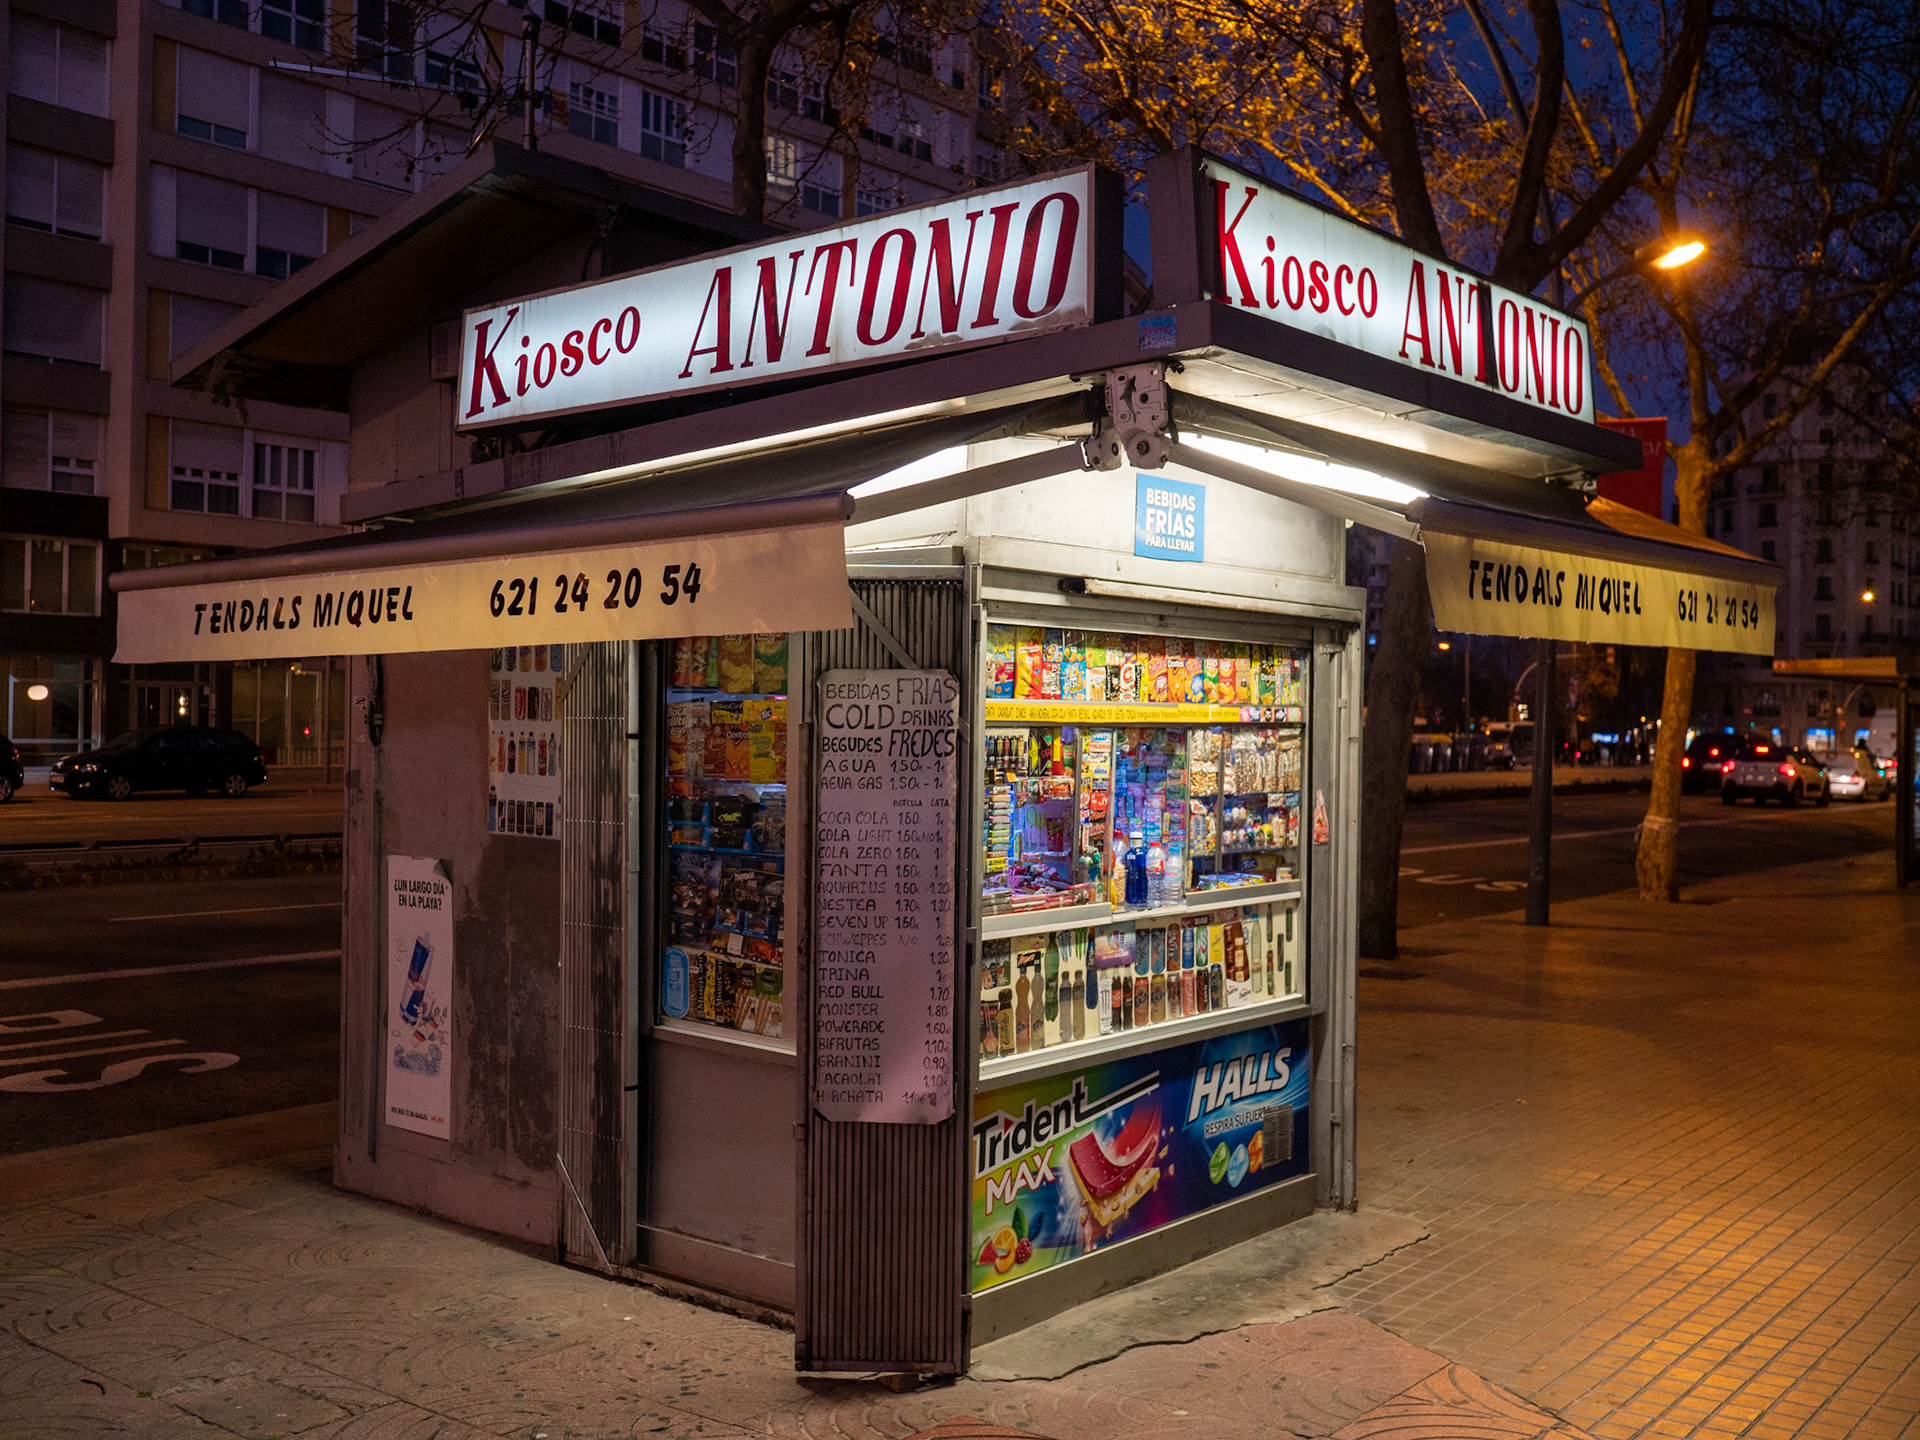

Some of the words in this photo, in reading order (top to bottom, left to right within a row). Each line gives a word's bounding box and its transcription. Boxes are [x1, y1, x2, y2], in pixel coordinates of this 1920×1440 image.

[1212, 179, 1378, 318] Kiosco
[1399, 259, 1584, 415] ANTONIO
[465, 305, 641, 419] Kiosco
[678, 191, 1080, 379] ANTONIO
[1146, 487, 1196, 512] BEBIDAS
[1145, 534, 1167, 549] PARA
[1168, 537, 1195, 552] LLEVAR
[194, 595, 303, 636] TENDALS
[312, 585, 414, 629] MIQUEL
[489, 576, 538, 619] 621
[554, 572, 590, 613] 24
[603, 566, 642, 610] 20
[661, 562, 702, 604] 54
[1468, 559, 1566, 608] TENDALS
[1575, 573, 1642, 616] MIQUEL
[1678, 589, 1698, 623] 621
[1741, 600, 1759, 630] 54
[826, 683, 891, 701] BEBIDAS
[896, 677, 957, 705] FRIAS
[825, 703, 896, 730] COLD
[900, 709, 955, 727] DRINKS
[822, 736, 883, 753] BEGUDES
[888, 728, 956, 758] FREDES
[822, 759, 876, 773] AGUA
[820, 776, 852, 790] AGUA
[857, 776, 883, 790] GAS
[930, 798, 949, 807] LATA
[818, 811, 851, 825] COCA
[855, 811, 889, 825] COLA
[818, 828, 850, 842] COLA
[857, 829, 892, 842] LIGHT
[817, 846, 849, 860] COLA
[856, 846, 892, 860] ZERO
[819, 863, 888, 878] FANTA
[394, 879, 407, 892] ¿UN
[409, 880, 432, 894] LARGO
[433, 879, 445, 896] DÍA
[817, 881, 886, 895] AQUARIUS
[398, 894, 407, 906] EN
[409, 895, 417, 907] LA
[418, 896, 442, 910] PLAYA?
[817, 898, 877, 911] NESTEA
[817, 915, 868, 928] SEVEN
[873, 915, 889, 929] UP
[818, 950, 876, 964] TONICA
[818, 967, 870, 981] TRINA
[819, 985, 845, 999] RED
[851, 985, 884, 999] BULL
[817, 1002, 879, 1016] MONSTER
[816, 1019, 885, 1034] POWERADE
[818, 1037, 881, 1051] BIFRUTAS
[817, 1054, 881, 1069] GRANINI
[1186, 1047, 1293, 1124] HALLS
[973, 1078, 1088, 1176] Trident
[1205, 1116, 1236, 1137] RESPIRA
[1235, 1114, 1244, 1128] SU
[985, 1145, 1057, 1216] MAX
